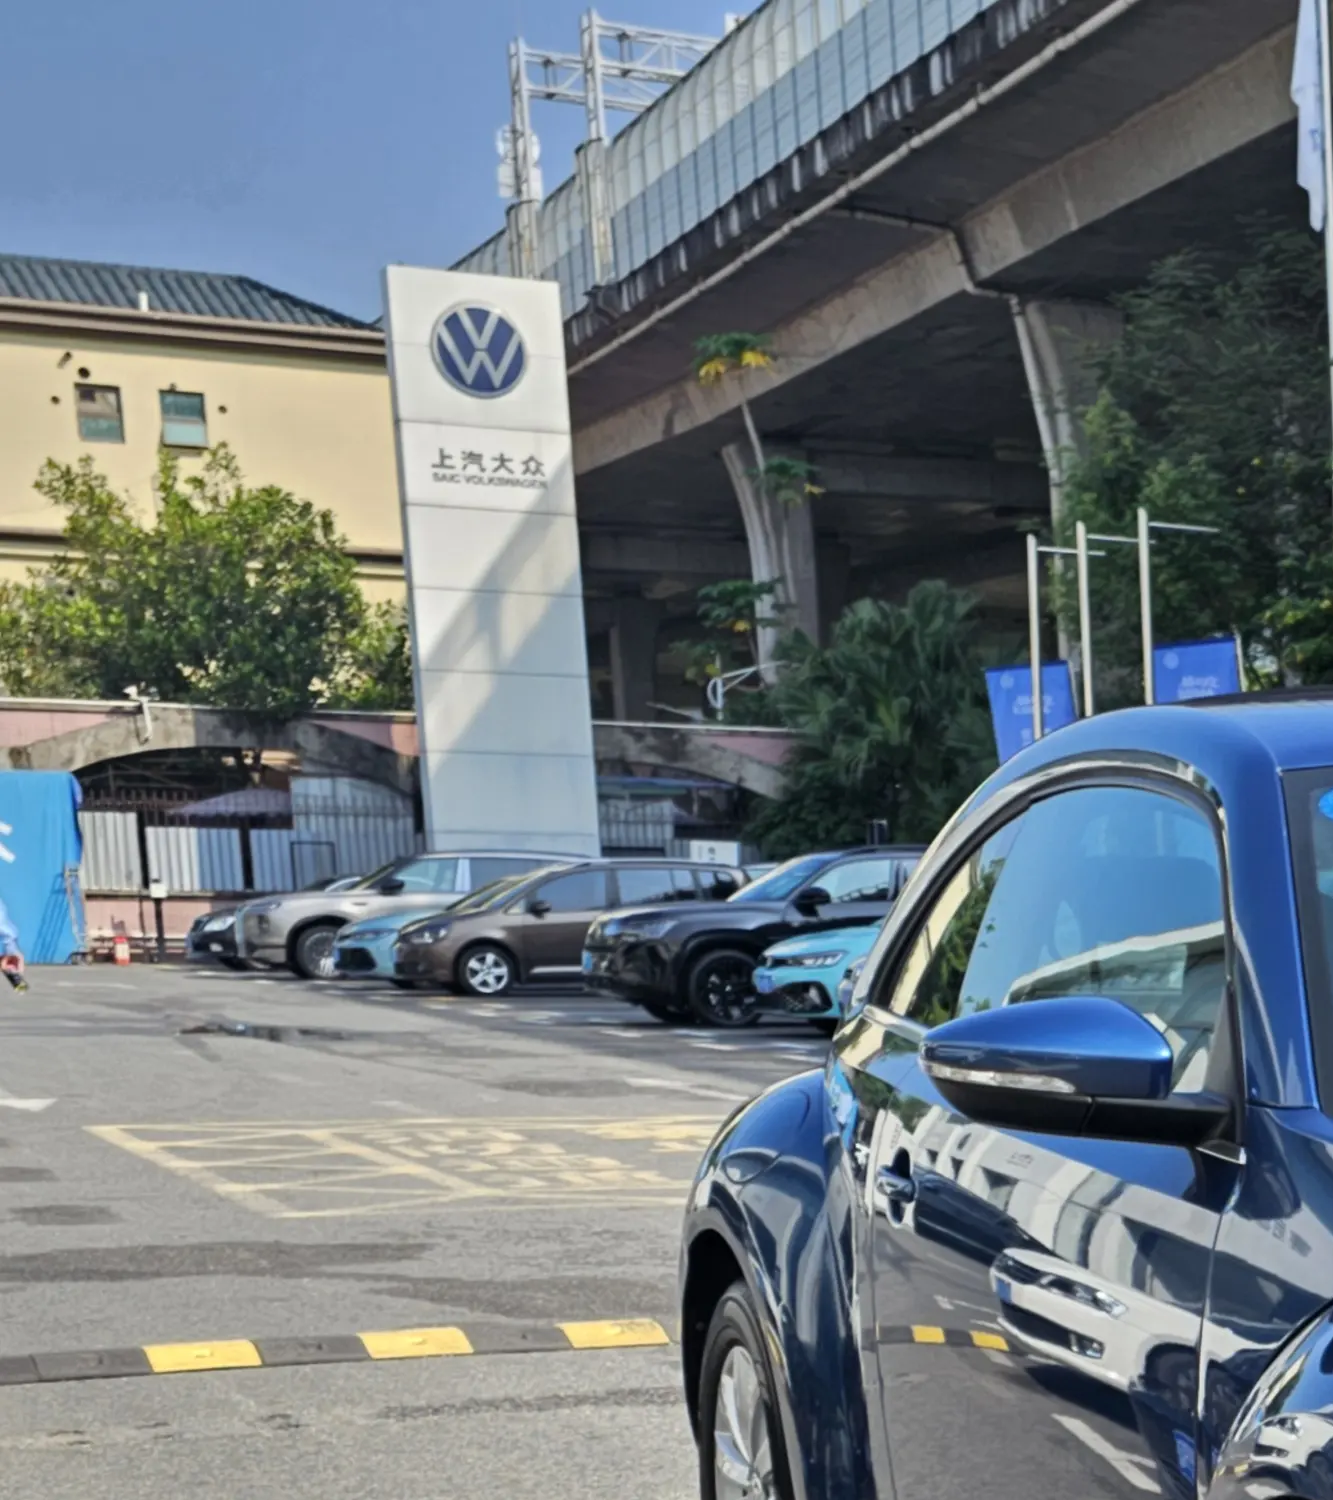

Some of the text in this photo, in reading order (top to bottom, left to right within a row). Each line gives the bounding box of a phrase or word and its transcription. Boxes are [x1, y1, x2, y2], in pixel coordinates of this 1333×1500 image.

[431, 447, 546, 477] 上汽大众
[432, 472, 461, 484] SAIC
